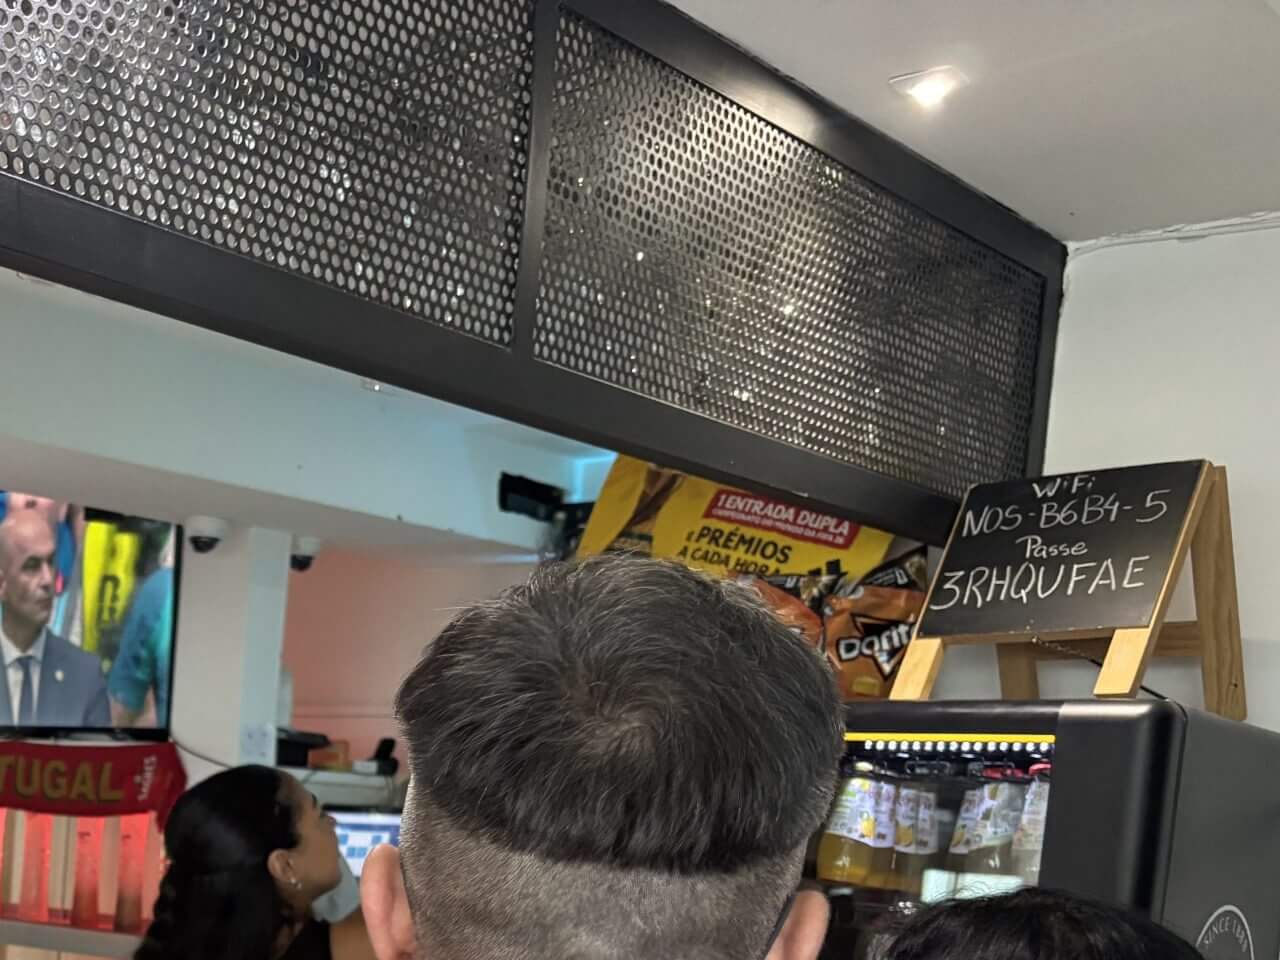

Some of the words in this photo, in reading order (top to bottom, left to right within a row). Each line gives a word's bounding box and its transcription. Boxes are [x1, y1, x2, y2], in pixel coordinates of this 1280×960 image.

[1032, 474, 1096, 498] WiFi
[724, 495, 795, 523] ENTRADA
[796, 510, 850, 537] DUPLA
[690, 548, 731, 568] CADA
[695, 526, 793, 564] PRÉMIOS
[1016, 535, 1089, 558] Passe
[839, 623, 916, 660] Dorit
